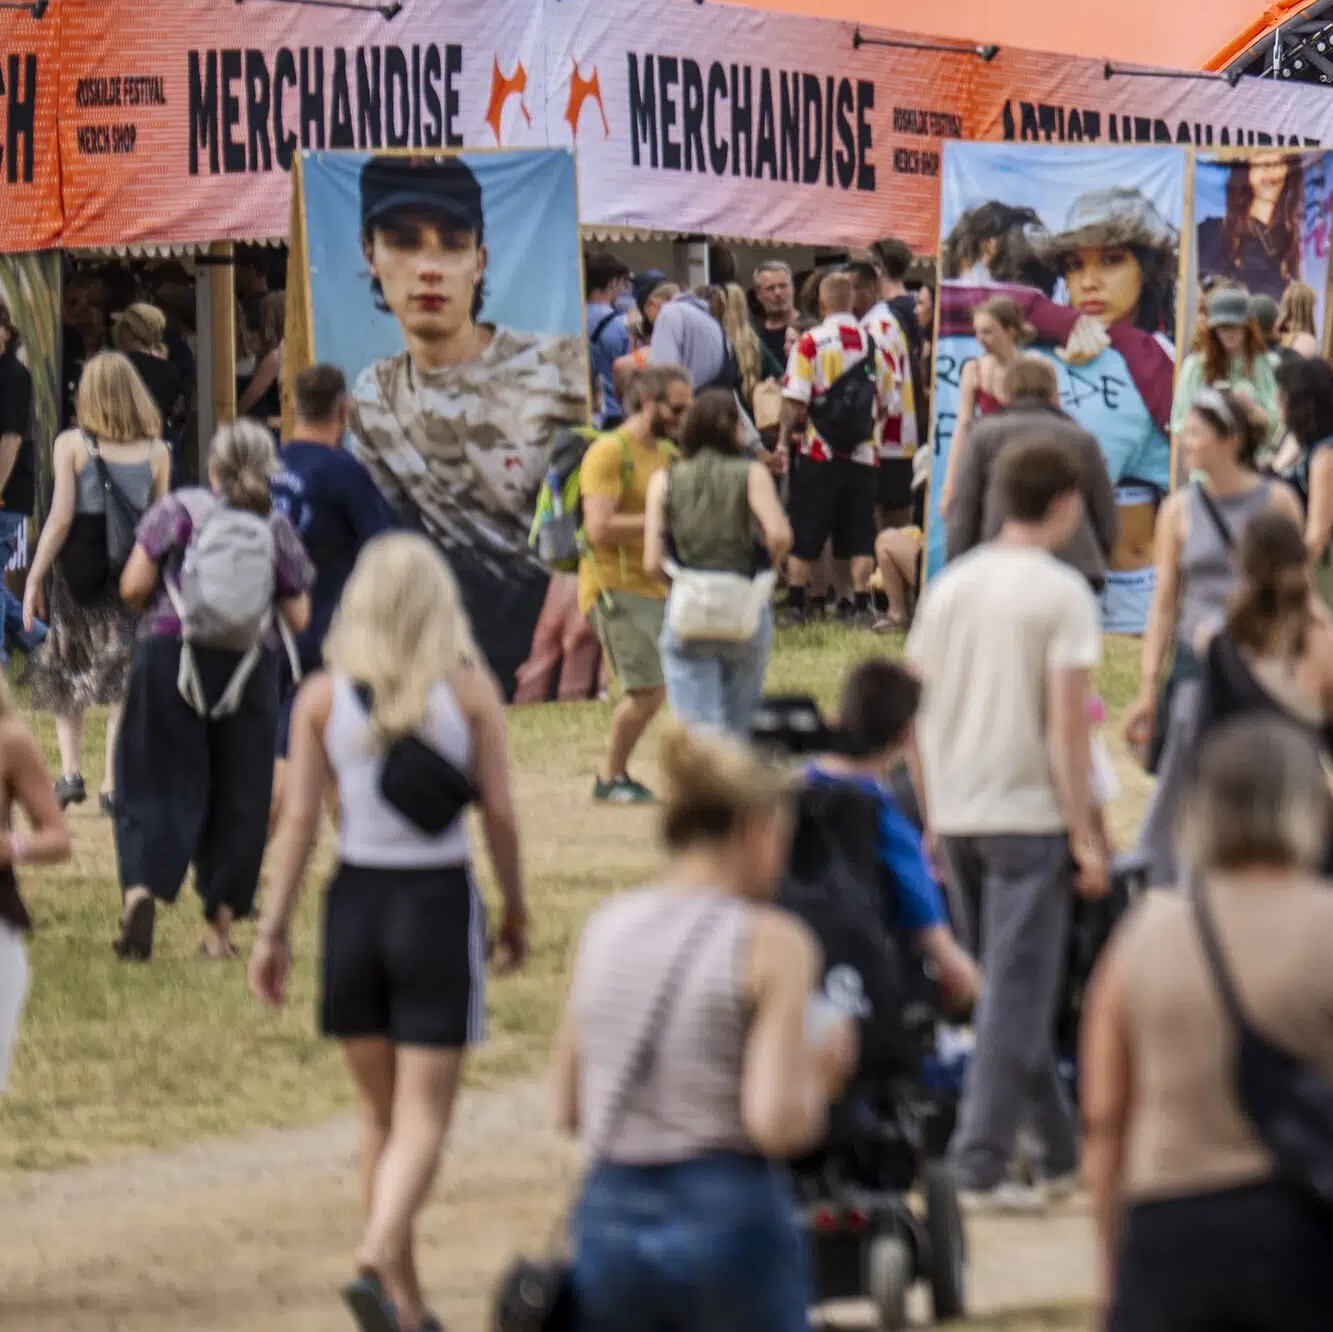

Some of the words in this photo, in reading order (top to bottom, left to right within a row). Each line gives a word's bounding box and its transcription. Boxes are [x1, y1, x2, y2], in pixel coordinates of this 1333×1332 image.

[0, 53, 37, 183] H
[76, 77, 122, 107] ROSKILDE
[123, 76, 167, 106] FESTIVAL
[77, 126, 110, 155] MERCH
[111, 124, 136, 154] SHOP
[188, 43, 463, 175] MERCHANDISE
[627, 52, 876, 191] MERCHANDISE
